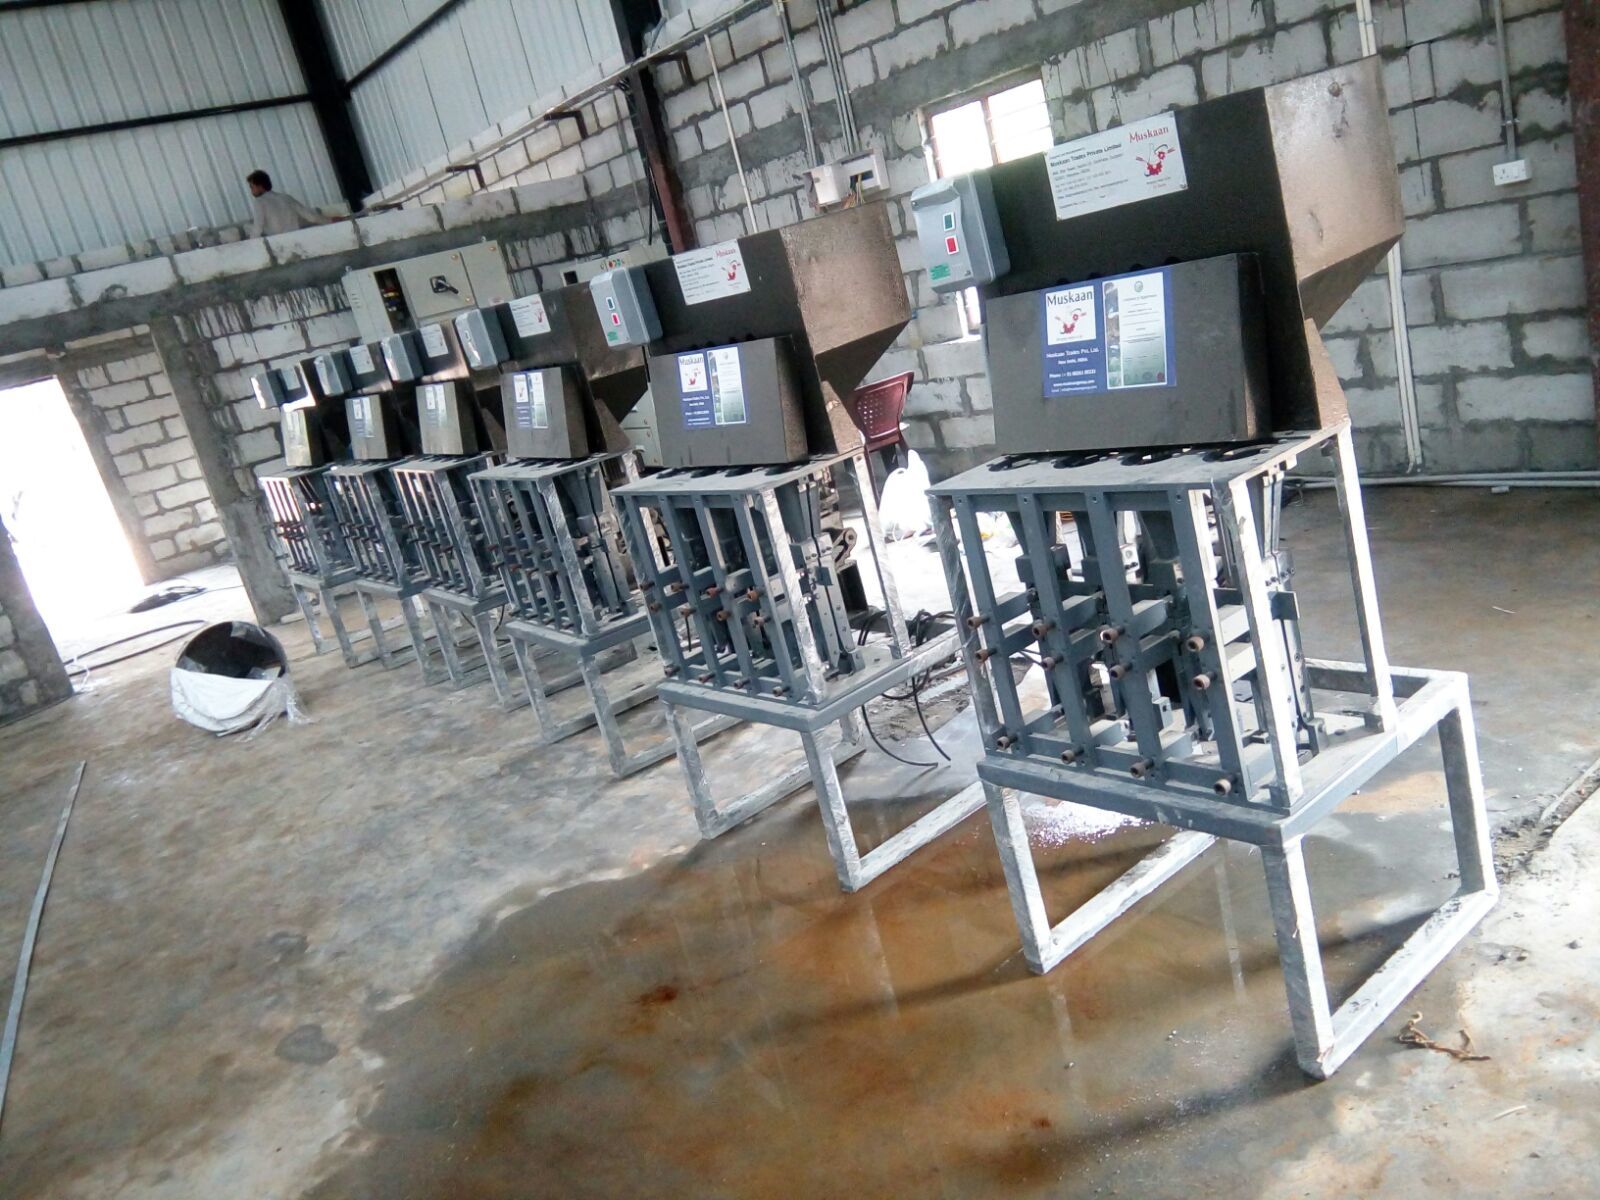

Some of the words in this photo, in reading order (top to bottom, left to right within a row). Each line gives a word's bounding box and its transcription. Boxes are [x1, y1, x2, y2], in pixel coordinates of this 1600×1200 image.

[1129, 126, 1169, 143] Muskaan
[1086, 148, 1103, 158] Private
[1104, 143, 1122, 153] Limited
[1047, 290, 1093, 307] Muskaan
